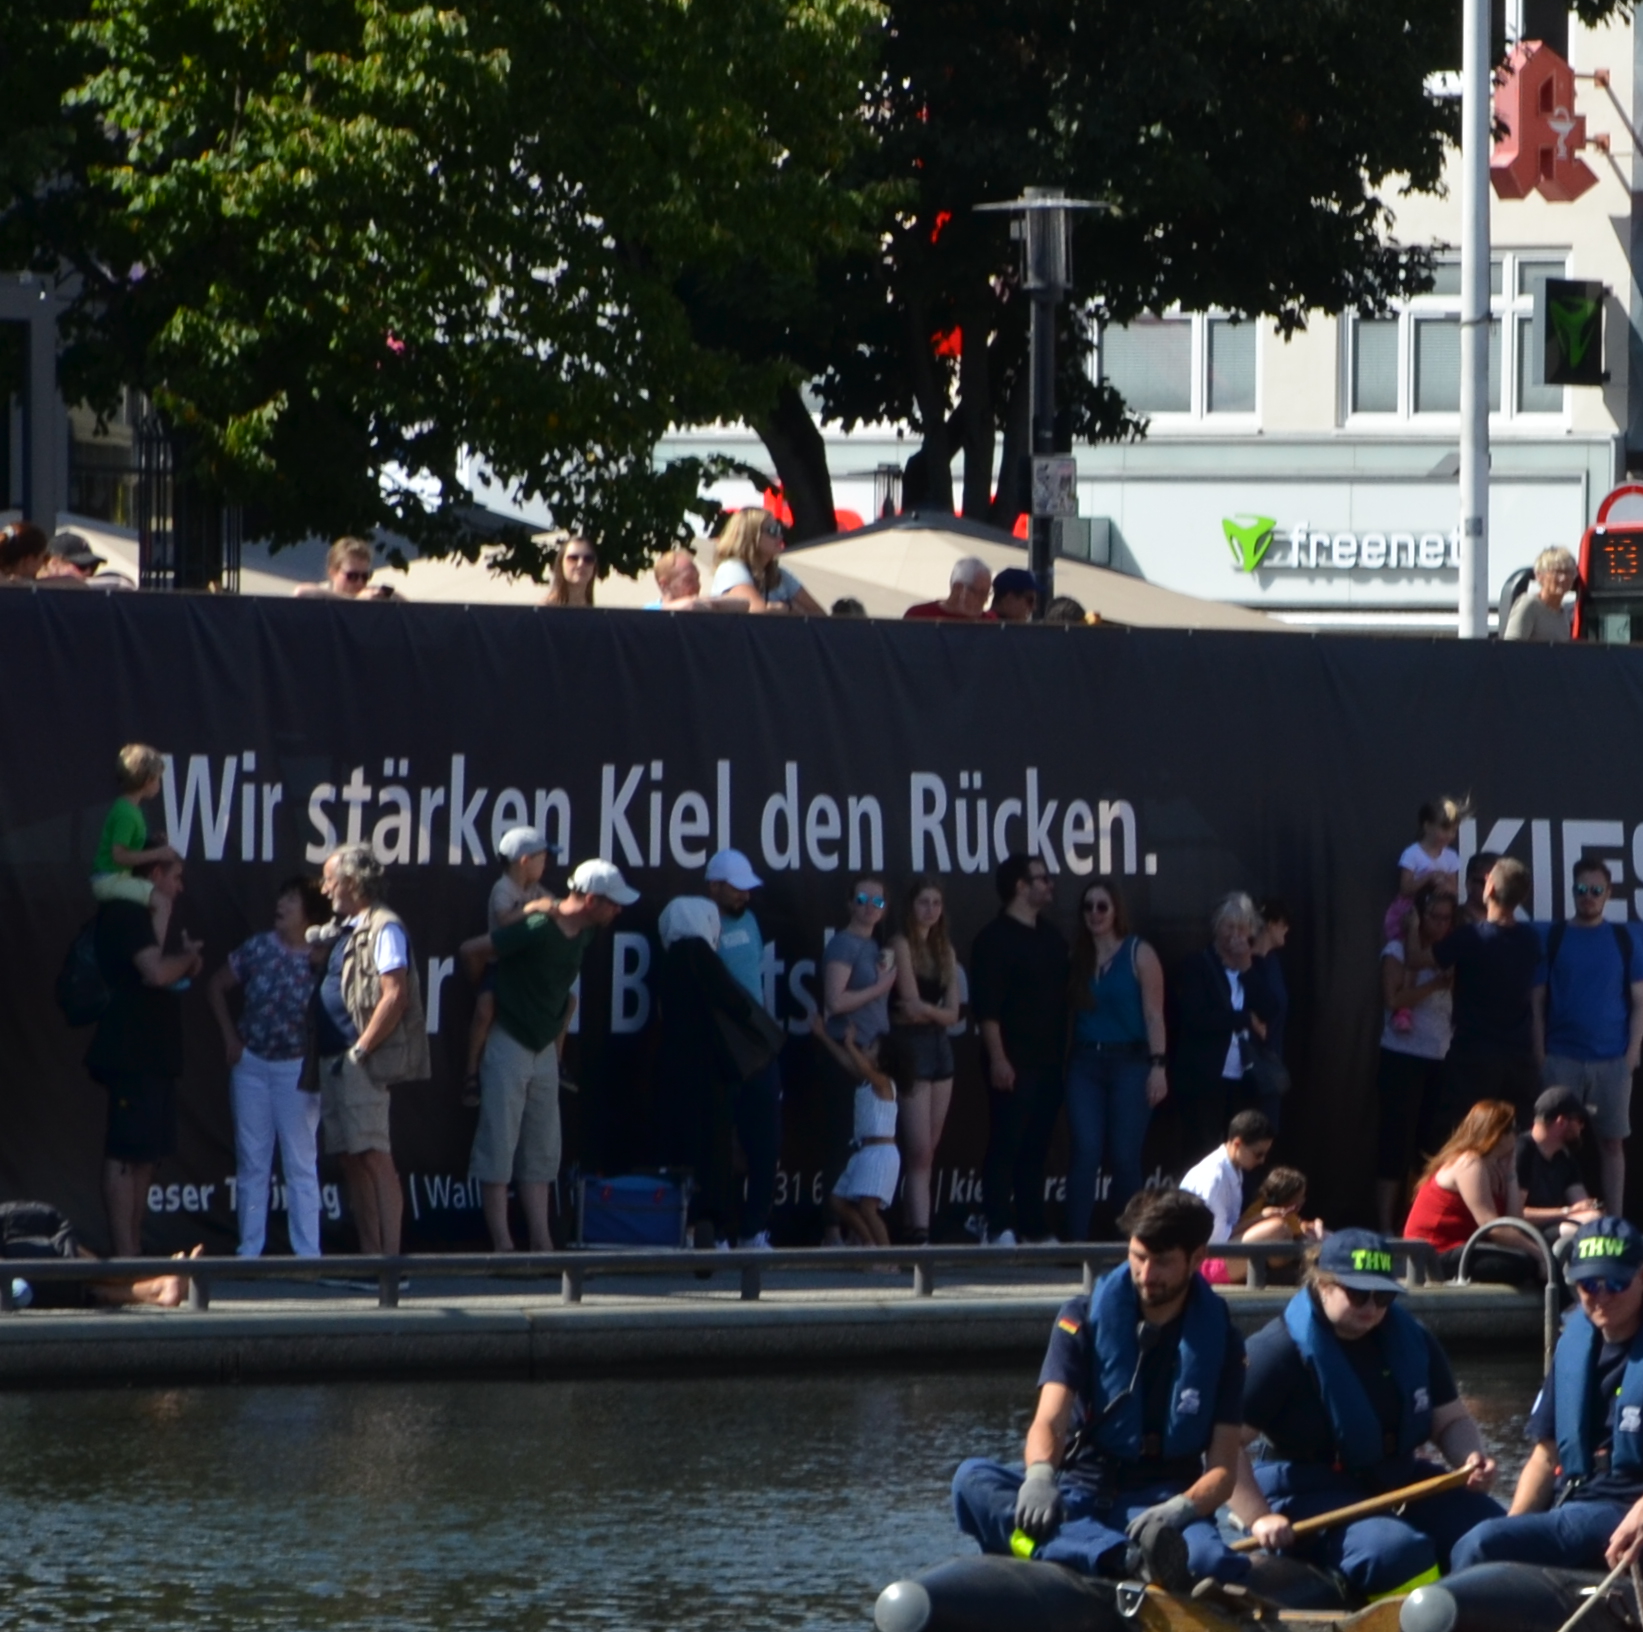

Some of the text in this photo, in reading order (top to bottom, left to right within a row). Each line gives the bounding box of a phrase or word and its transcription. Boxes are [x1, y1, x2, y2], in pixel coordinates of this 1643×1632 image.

[1290, 521, 1461, 569] freenet
[1603, 538, 1638, 580] 13
[162, 751, 1158, 876] Wir stärken Kiel den Rücken.
[1350, 1249, 1392, 1272] THW
[1578, 1236, 1628, 1259] THW
